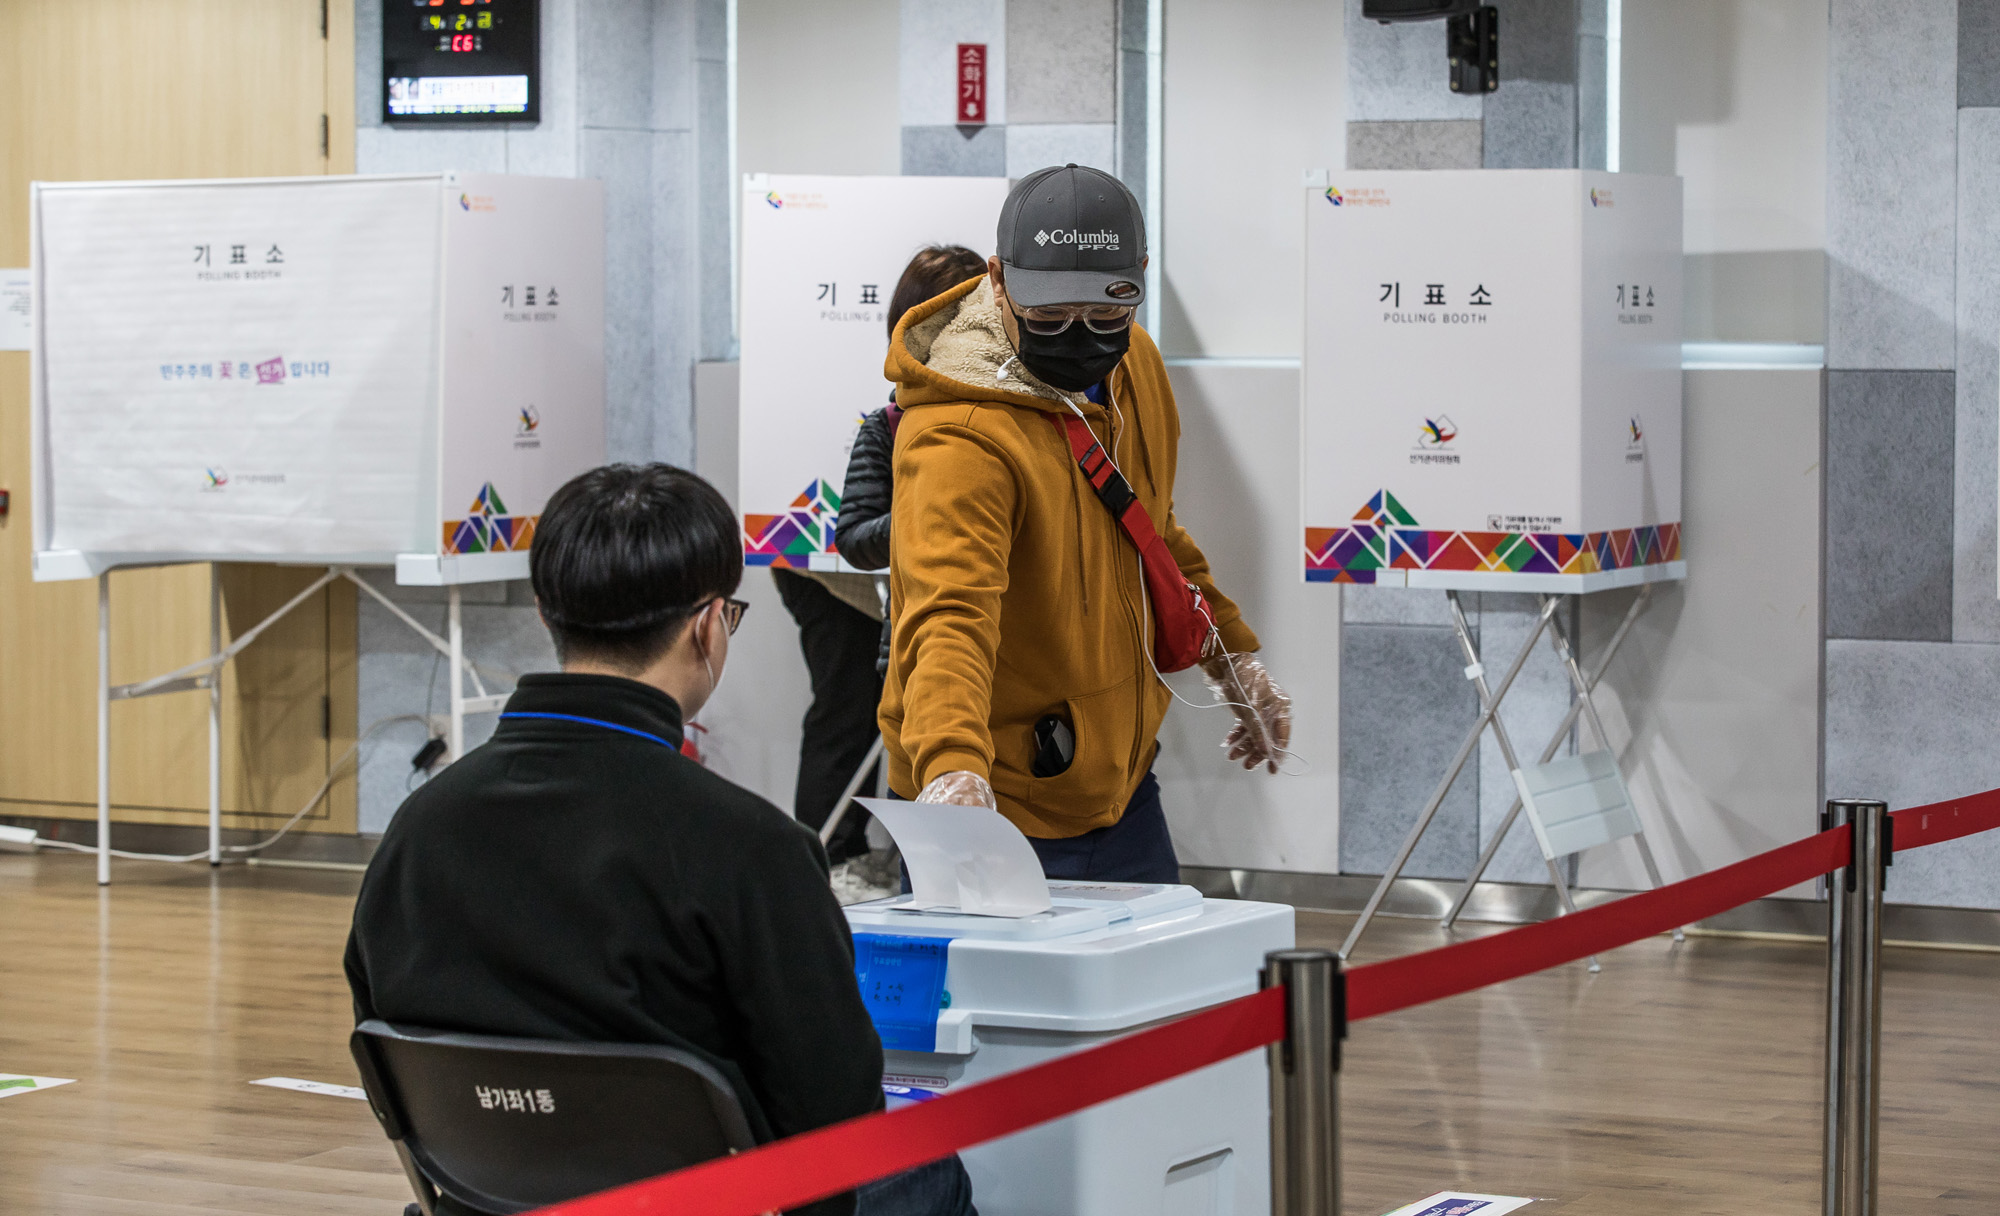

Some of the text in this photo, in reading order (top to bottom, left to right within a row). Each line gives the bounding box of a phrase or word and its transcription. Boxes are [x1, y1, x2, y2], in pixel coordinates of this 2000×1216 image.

[962, 48, 981, 101] 소화기
[1050, 229, 1120, 245] Columbia
[198, 270, 281, 281] POLLING BOOTH
[820, 311, 871, 322] POLLING
[1383, 312, 1487, 324] POLLING BOOTH
[475, 1084, 556, 1114] 남가좌1동
